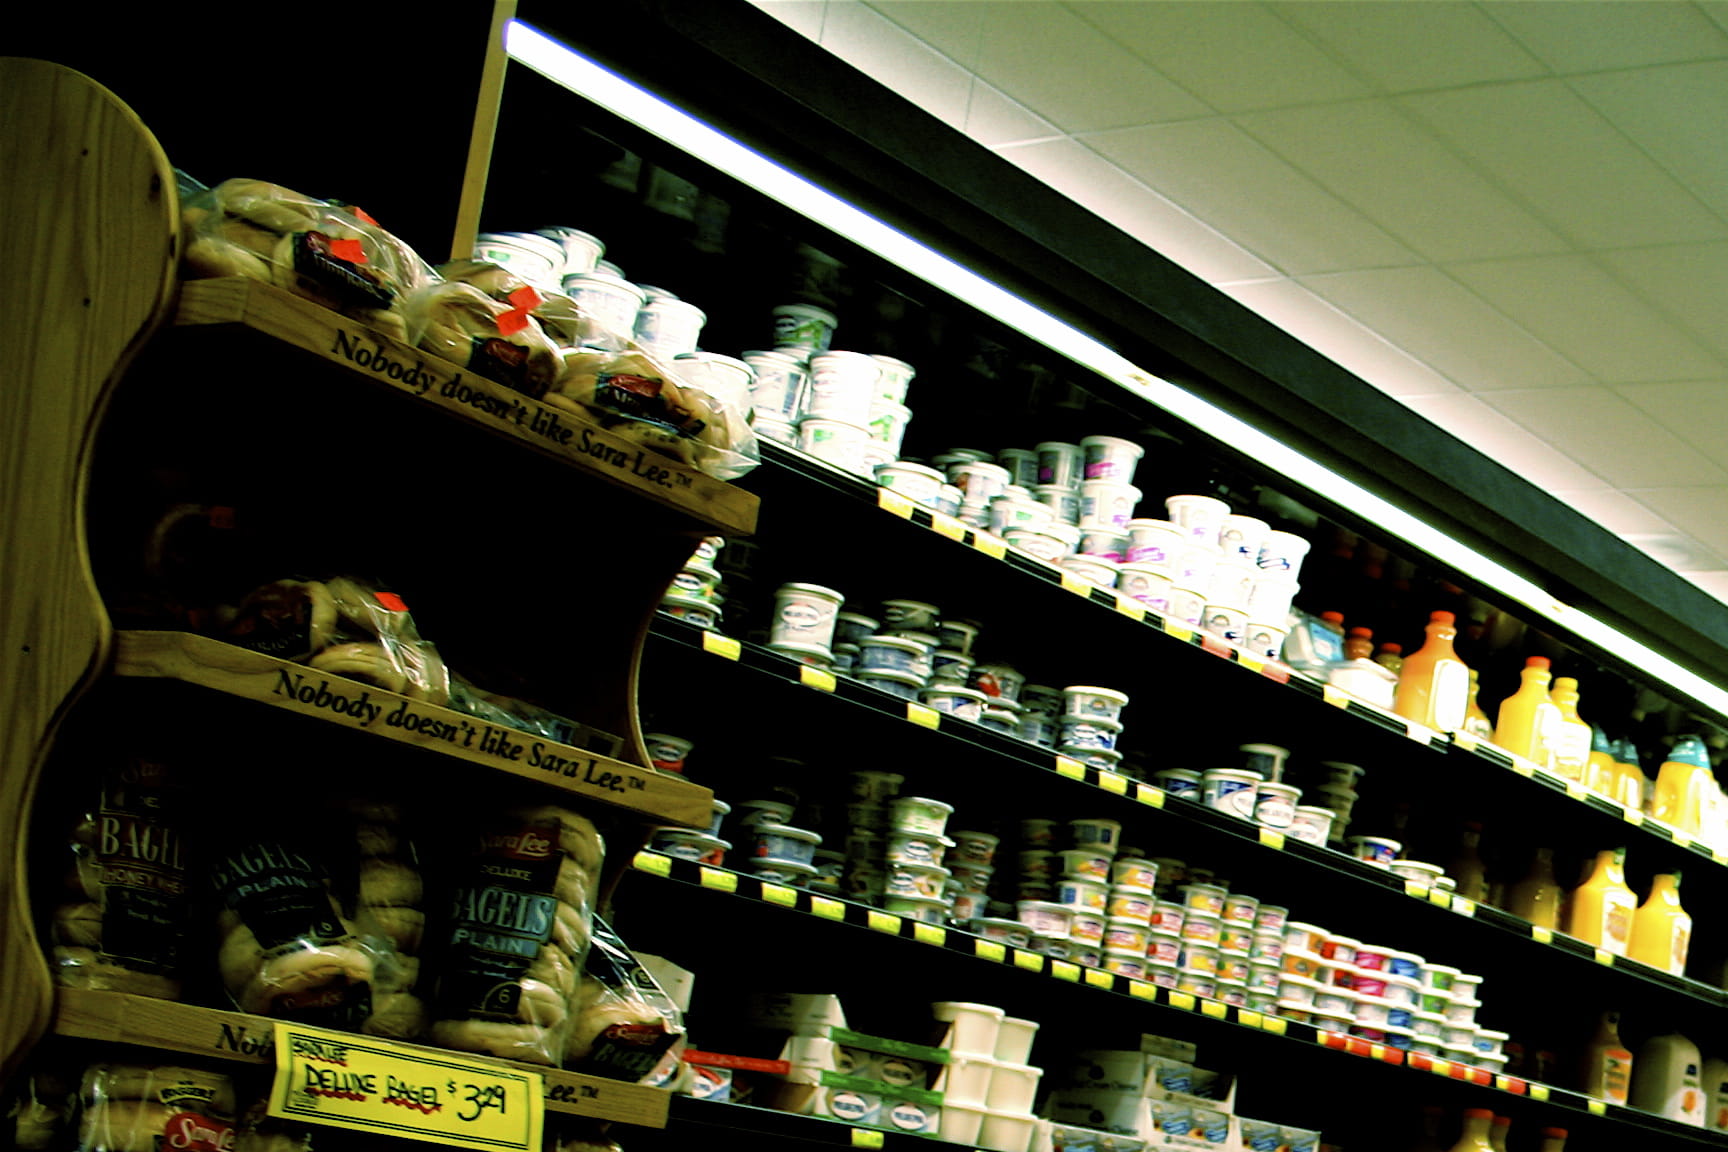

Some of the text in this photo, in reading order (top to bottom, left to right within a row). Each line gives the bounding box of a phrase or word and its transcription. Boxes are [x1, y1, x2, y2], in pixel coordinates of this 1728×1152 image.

[331, 329, 435, 395] Nobody
[440, 373, 528, 423] doesn't
[530, 414, 574, 446] like
[577, 428, 626, 468] Sara
[272, 668, 381, 727] Nobody
[386, 701, 476, 748] doesn't
[479, 725, 523, 761] like
[527, 741, 578, 778] Sara
[516, 832, 552, 858] Lee
[237, 874, 310, 899] PLAIN
[451, 885, 552, 937] BAGELS
[453, 928, 525, 953] PLAIN
[498, 987, 510, 1004] 6
[306, 1063, 378, 1095] DELUXE
[386, 1074, 442, 1107] BAGEL
